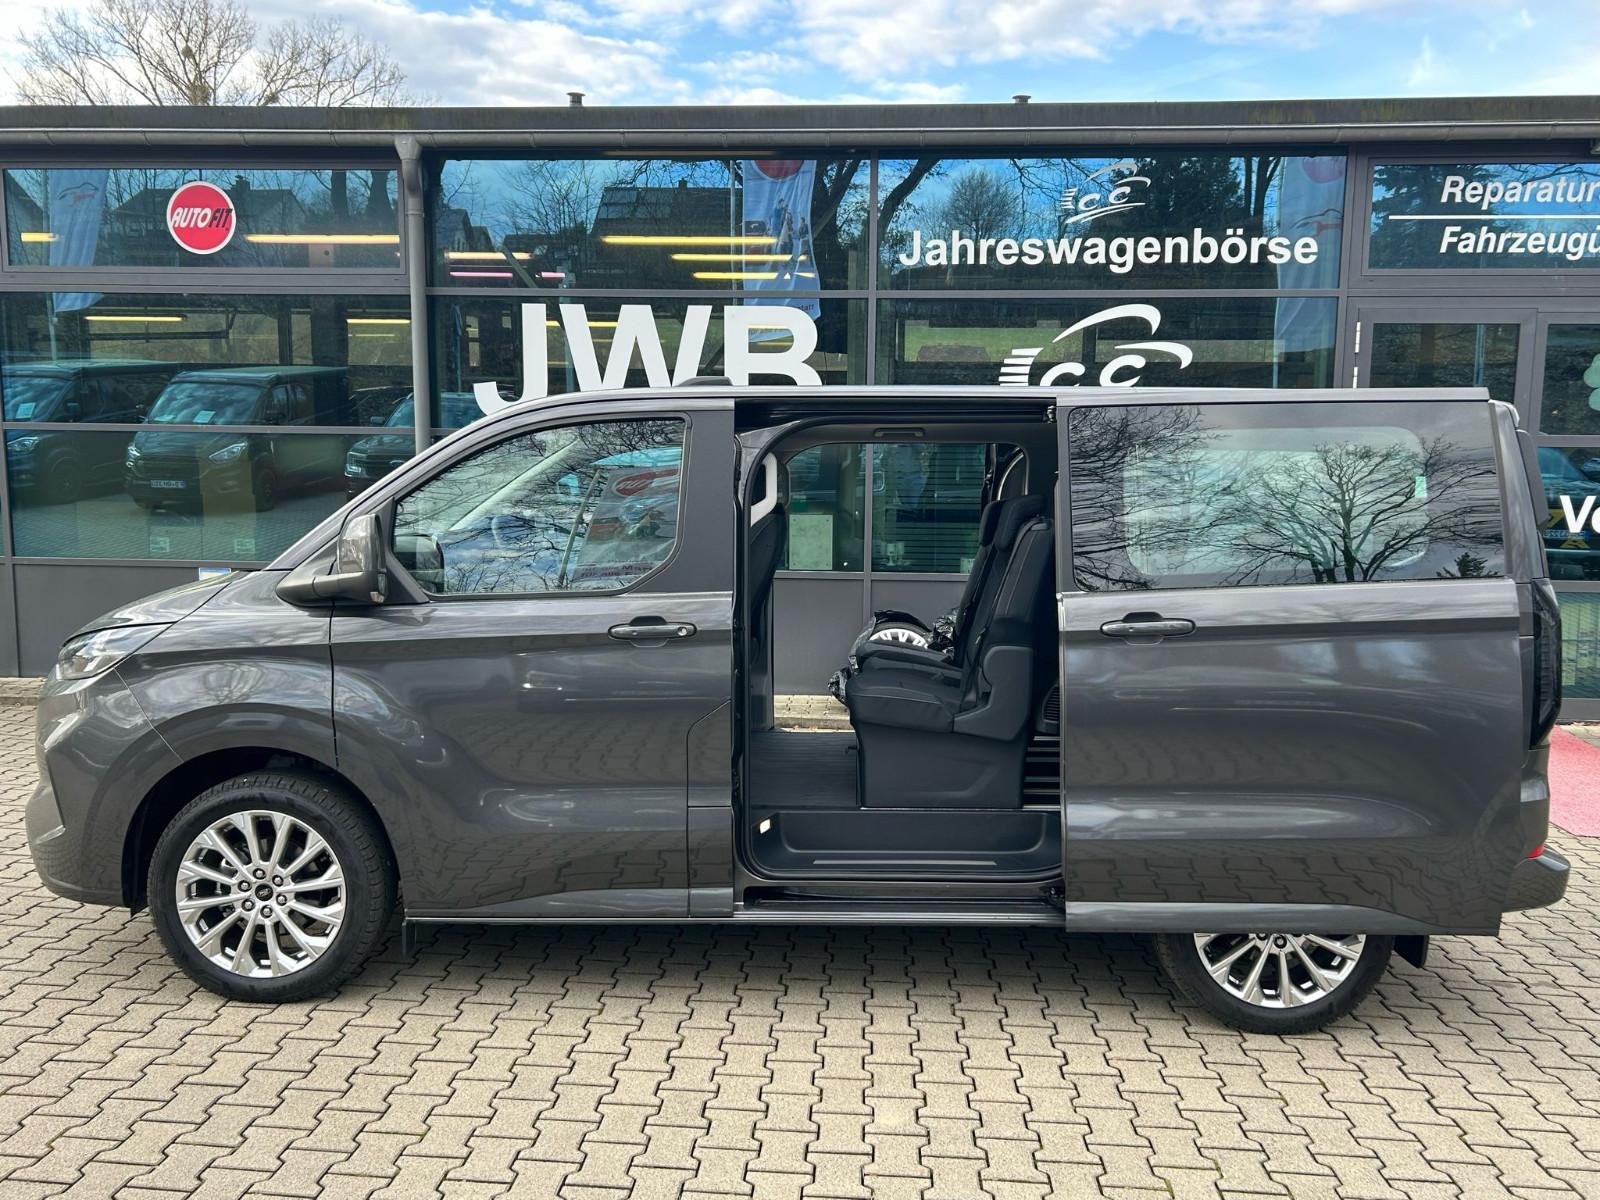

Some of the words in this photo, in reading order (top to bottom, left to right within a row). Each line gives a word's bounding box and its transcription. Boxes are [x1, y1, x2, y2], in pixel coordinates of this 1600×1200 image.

[1441, 175, 1600, 210] Reparatur
[171, 207, 233, 229] AUTOFIT
[898, 228, 1320, 274] Jahreswagenbörse
[1559, 494, 1600, 535] V
